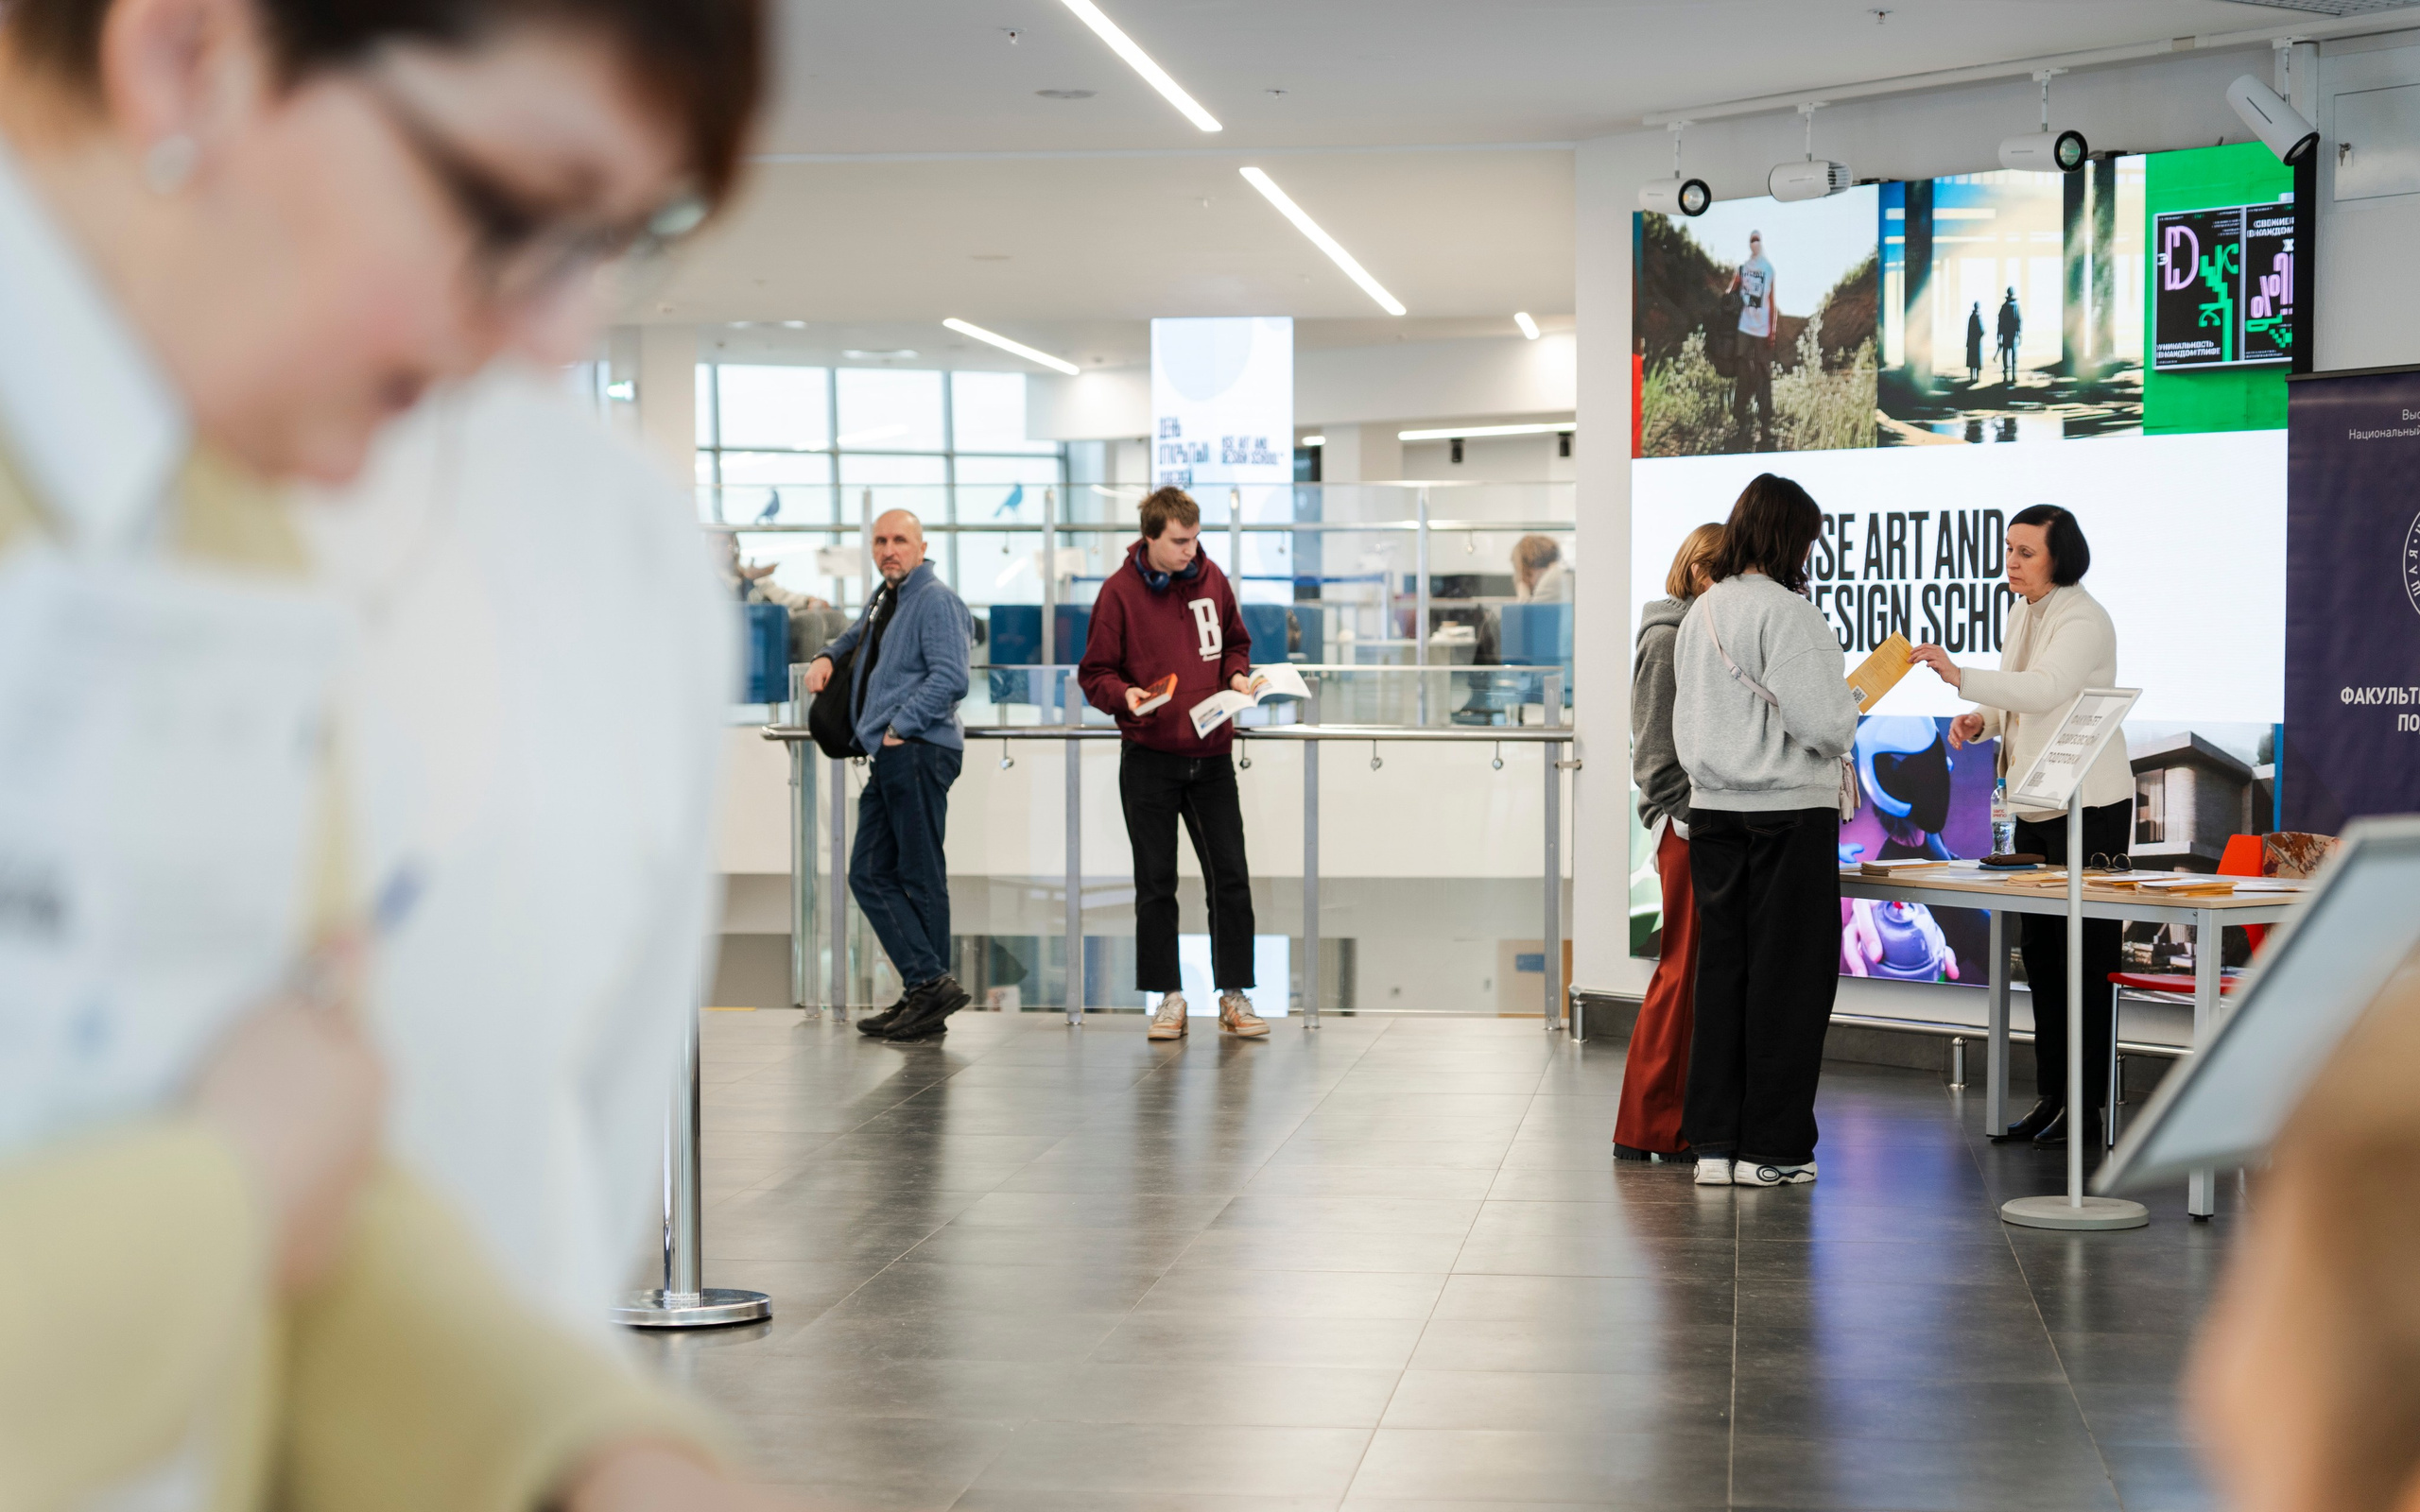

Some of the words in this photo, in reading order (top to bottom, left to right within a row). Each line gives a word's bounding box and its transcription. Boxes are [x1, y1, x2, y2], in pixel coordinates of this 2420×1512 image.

[1806, 512, 1856, 581] SE
[1863, 511, 1929, 580] ART
[1934, 508, 2004, 579] AND
[1921, 582, 2024, 653] SCHO
[2341, 687, 2420, 705] ФАКУЛЬТ
[2398, 713, 2420, 732] ПО
